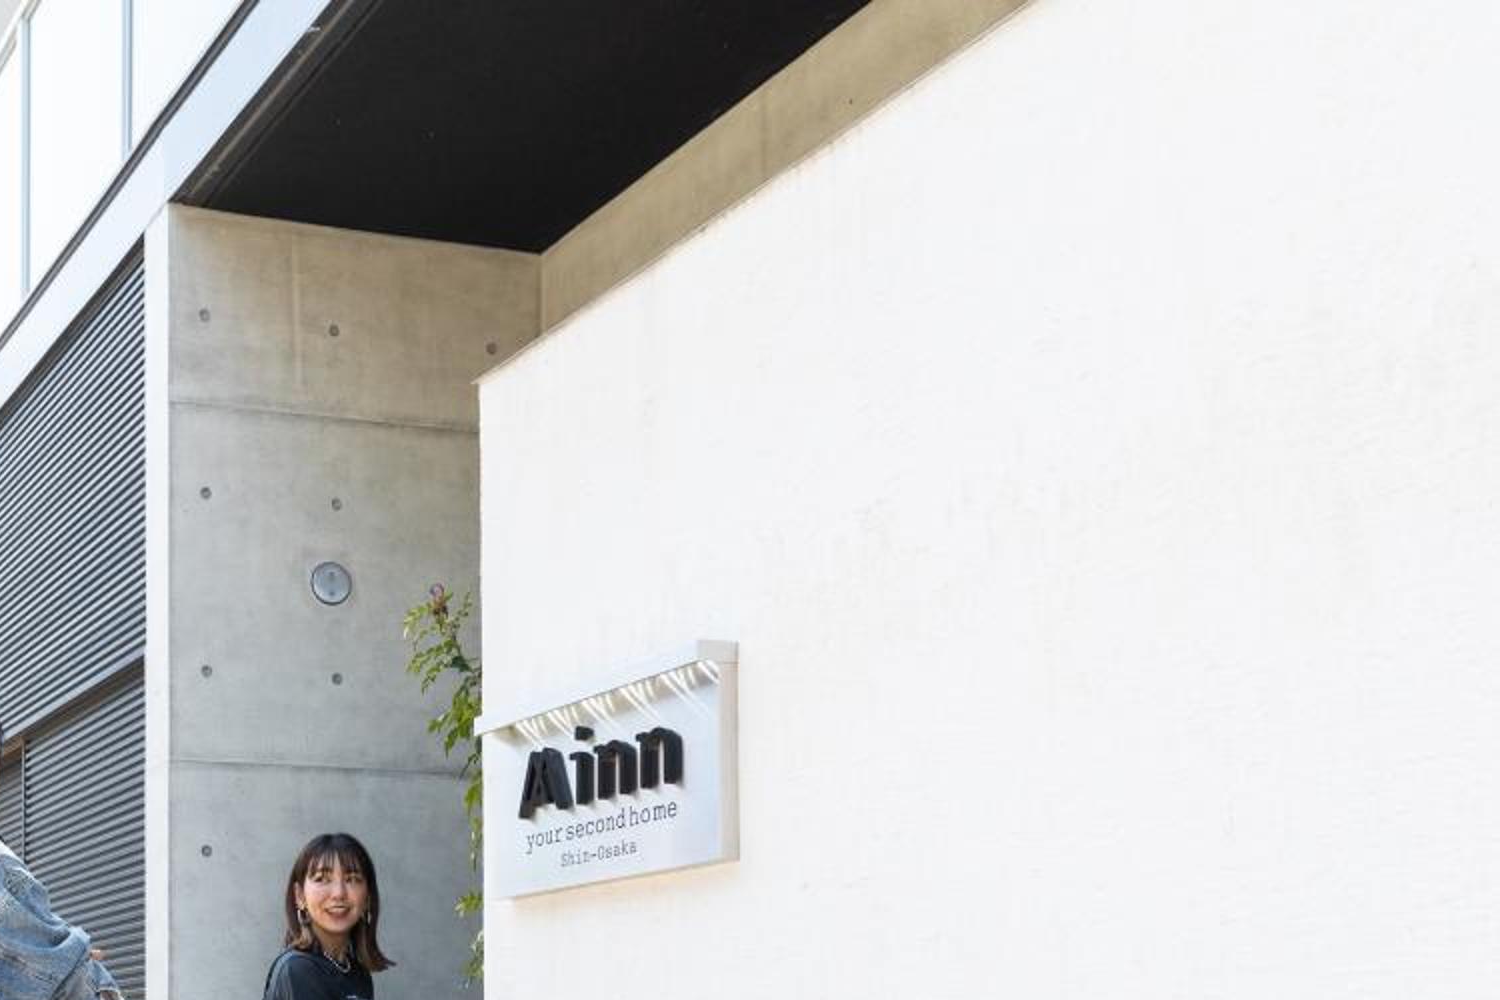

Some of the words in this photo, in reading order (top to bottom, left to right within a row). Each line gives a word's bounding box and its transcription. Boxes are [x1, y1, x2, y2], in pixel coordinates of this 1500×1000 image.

[518, 725, 684, 819] Ainn
[526, 826, 565, 855] your
[566, 807, 626, 841] second
[629, 800, 678, 828] home
[561, 840, 638, 867] Shin-Osaka
